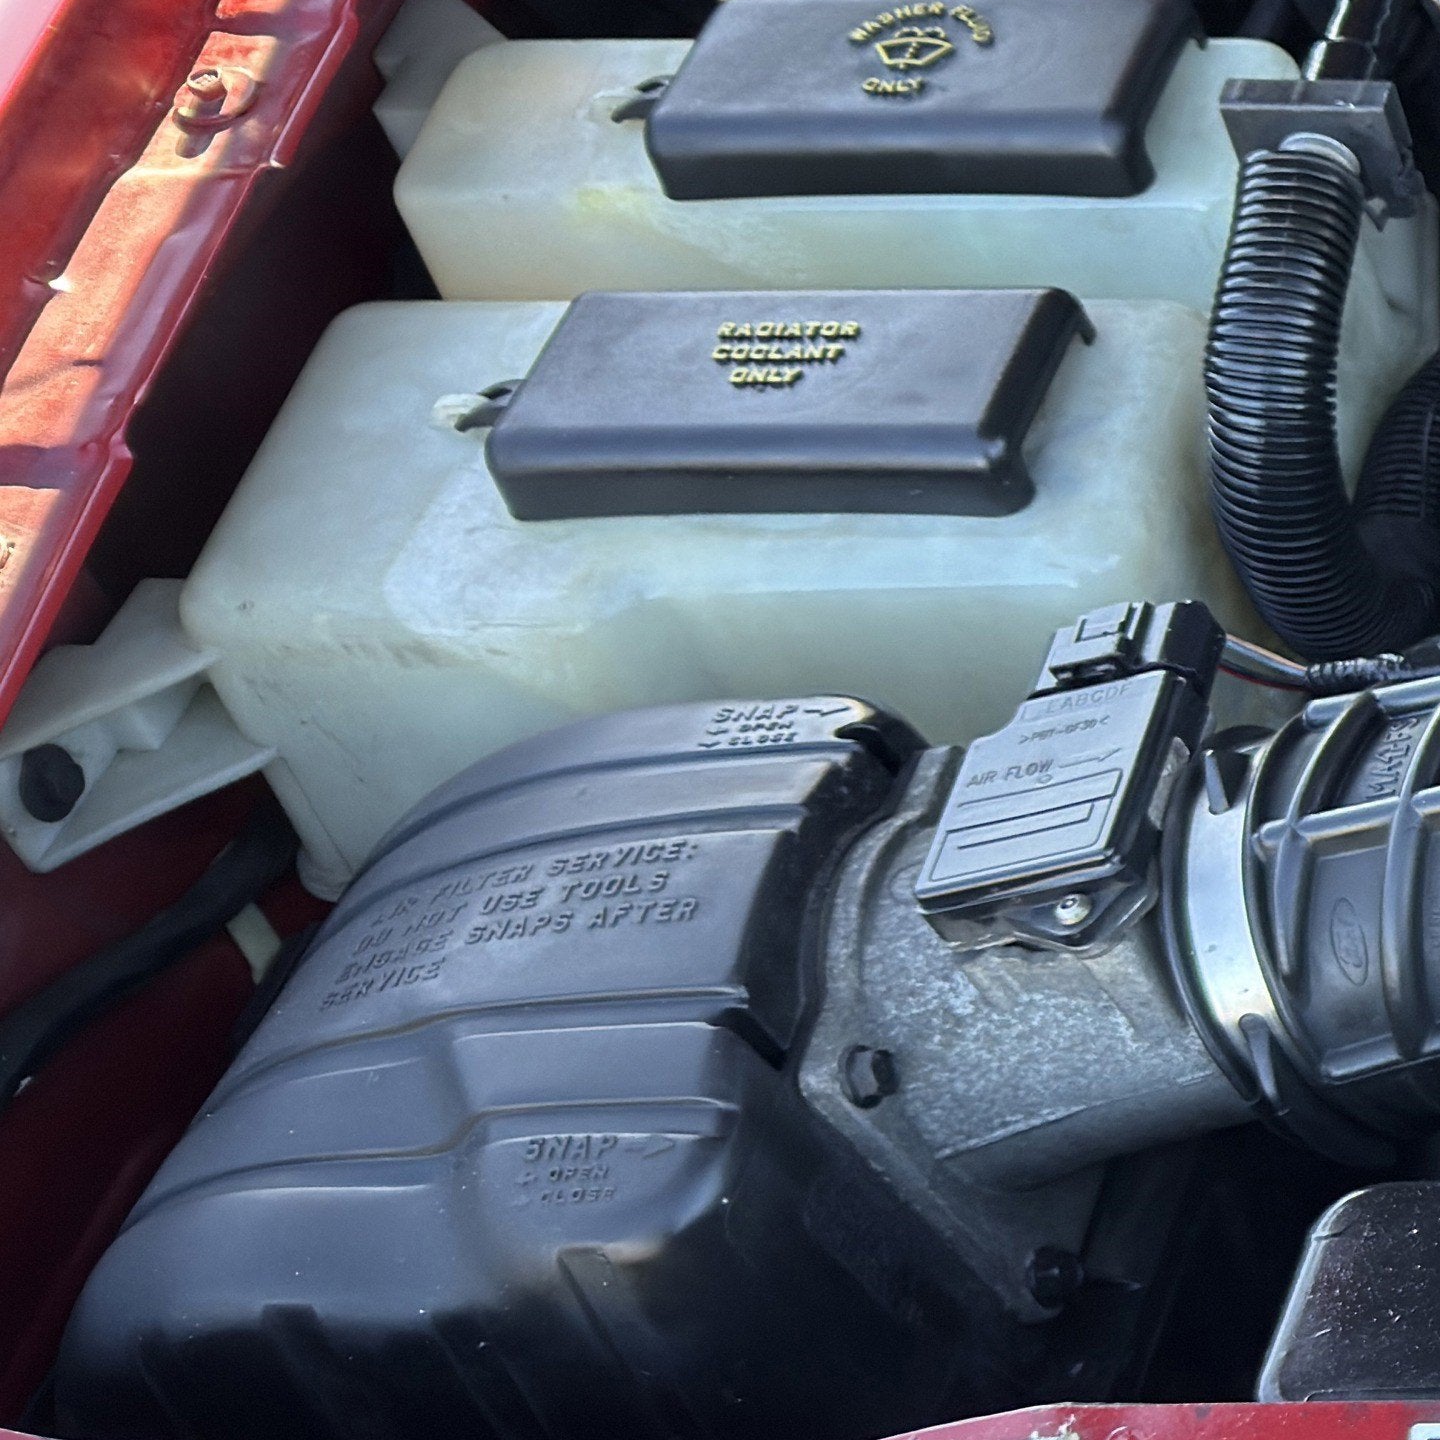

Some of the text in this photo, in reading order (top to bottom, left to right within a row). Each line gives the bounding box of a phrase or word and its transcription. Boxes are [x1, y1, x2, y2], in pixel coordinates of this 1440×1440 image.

[862, 77, 926, 96] ONLY
[716, 321, 860, 339] RADIATOR
[712, 343, 844, 362] COOLANT
[728, 366, 803, 386] ONLY
[712, 705, 799, 723] SNAP
[966, 759, 1054, 788] AIR FLOW
[549, 840, 698, 877] SERVICE:
[480, 888, 544, 915] USE
[561, 870, 670, 902] TOOLS
[464, 911, 573, 945] SNAPS
[587, 897, 698, 930] AFTER
